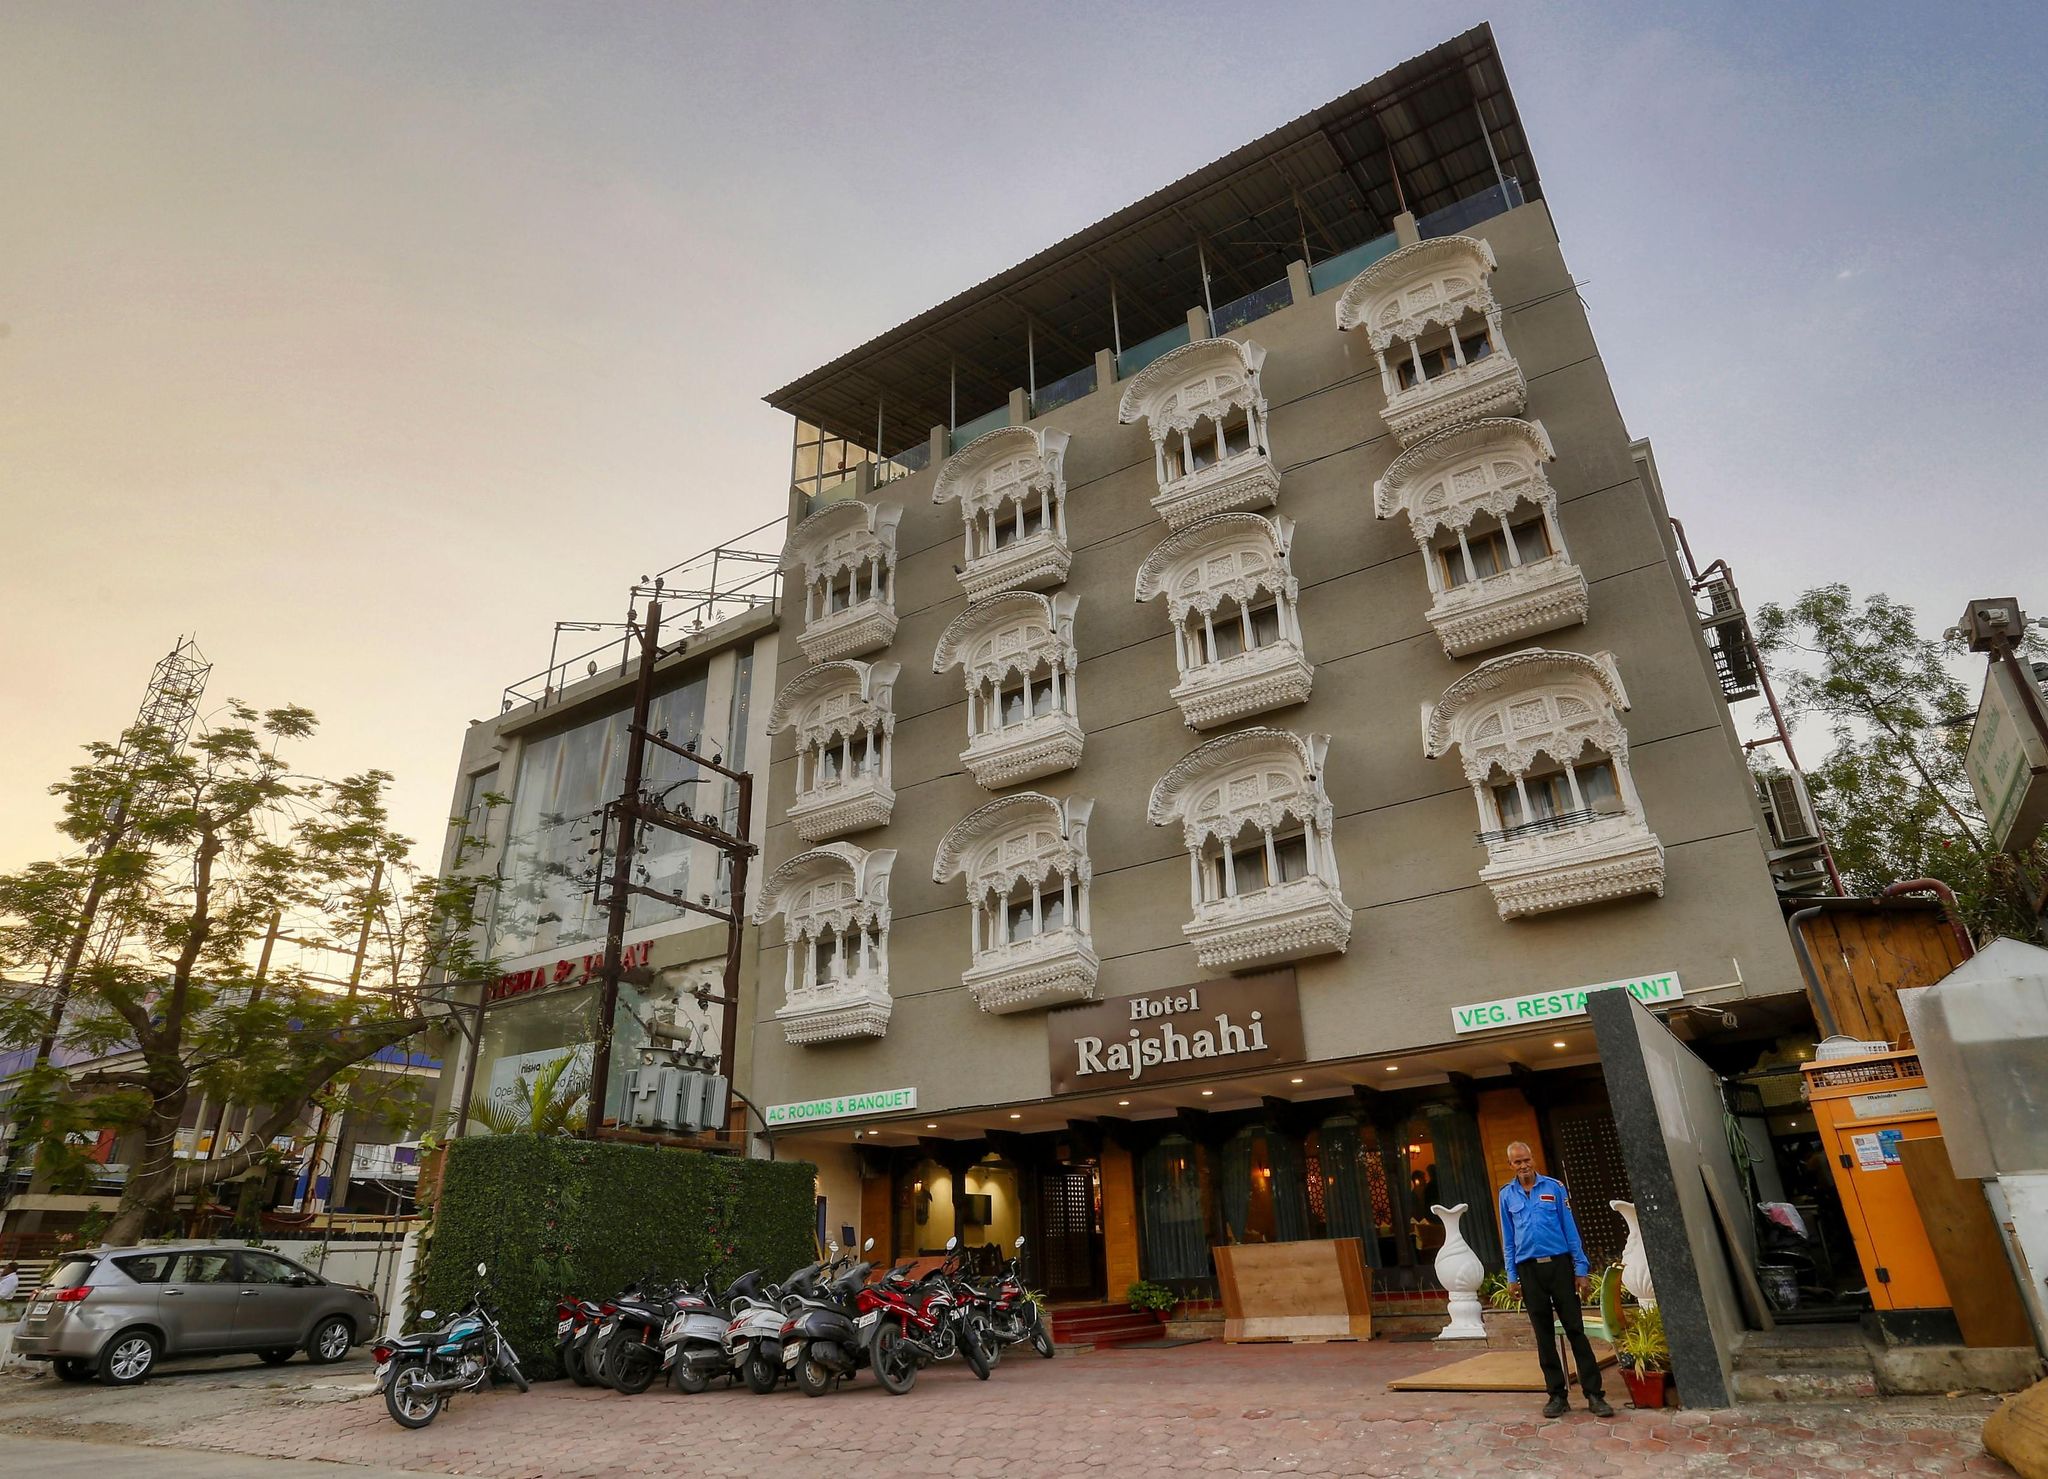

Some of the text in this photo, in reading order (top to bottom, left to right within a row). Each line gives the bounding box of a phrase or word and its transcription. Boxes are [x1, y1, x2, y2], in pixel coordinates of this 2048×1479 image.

[553, 959, 576, 983] &
[578, 940, 654, 986] JAAT
[1129, 988, 1201, 1021] Hotel
[1458, 977, 1673, 1027] VEG. RESTAANT
[1073, 1010, 1268, 1080] Rajshahi
[768, 1091, 911, 1122] AC ROOMS & BANQUET
